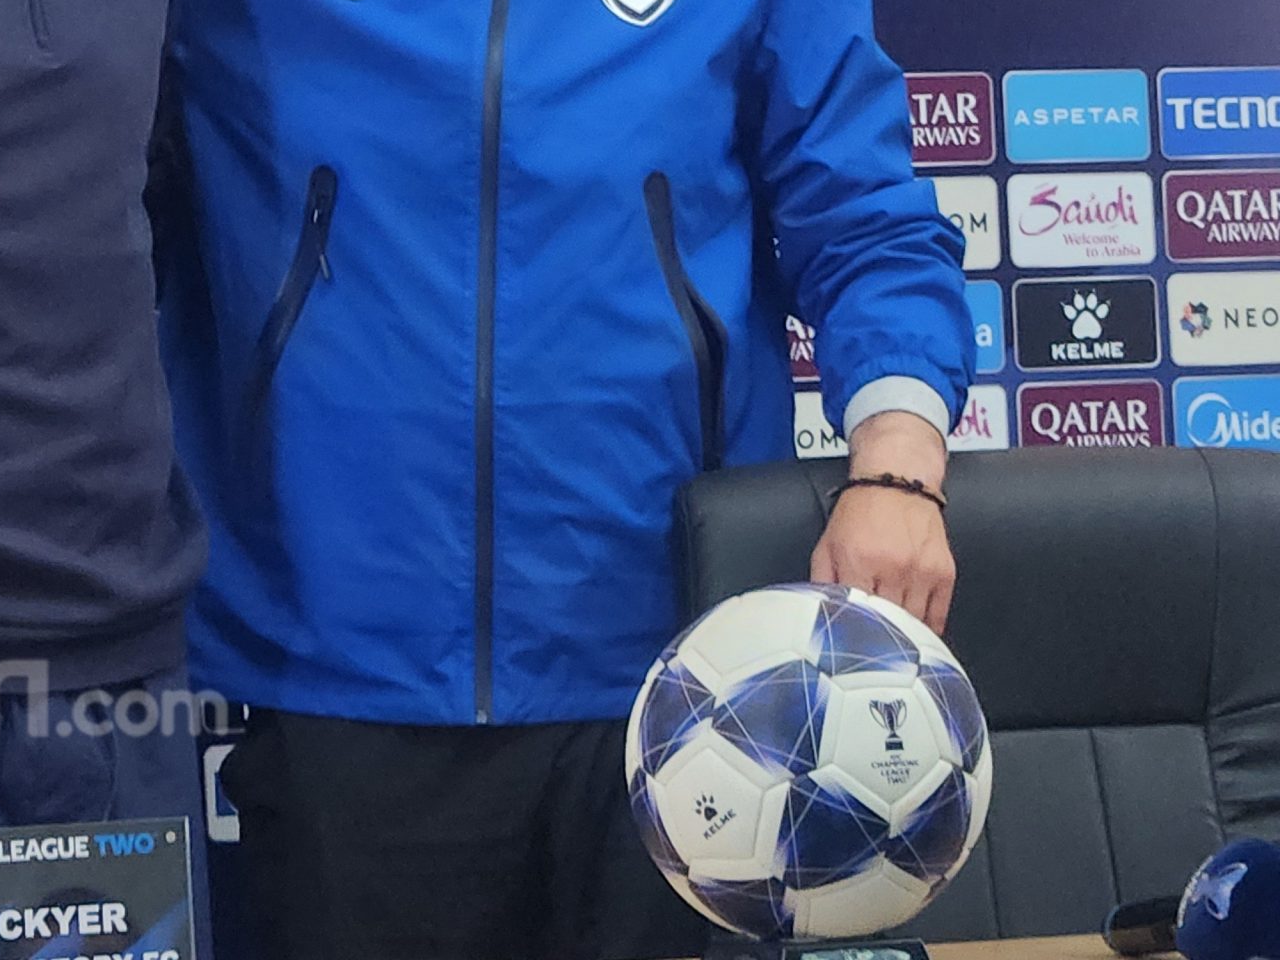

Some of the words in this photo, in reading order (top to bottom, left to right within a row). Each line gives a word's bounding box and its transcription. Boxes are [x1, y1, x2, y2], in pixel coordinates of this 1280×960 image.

[909, 93, 979, 125] TAR
[1014, 106, 1140, 125] ASPETAR
[1019, 185, 1138, 236] Saudi
[1051, 341, 1124, 360] KELME
[1031, 400, 1149, 441] QATAR
[94, 832, 154, 855] TWO
